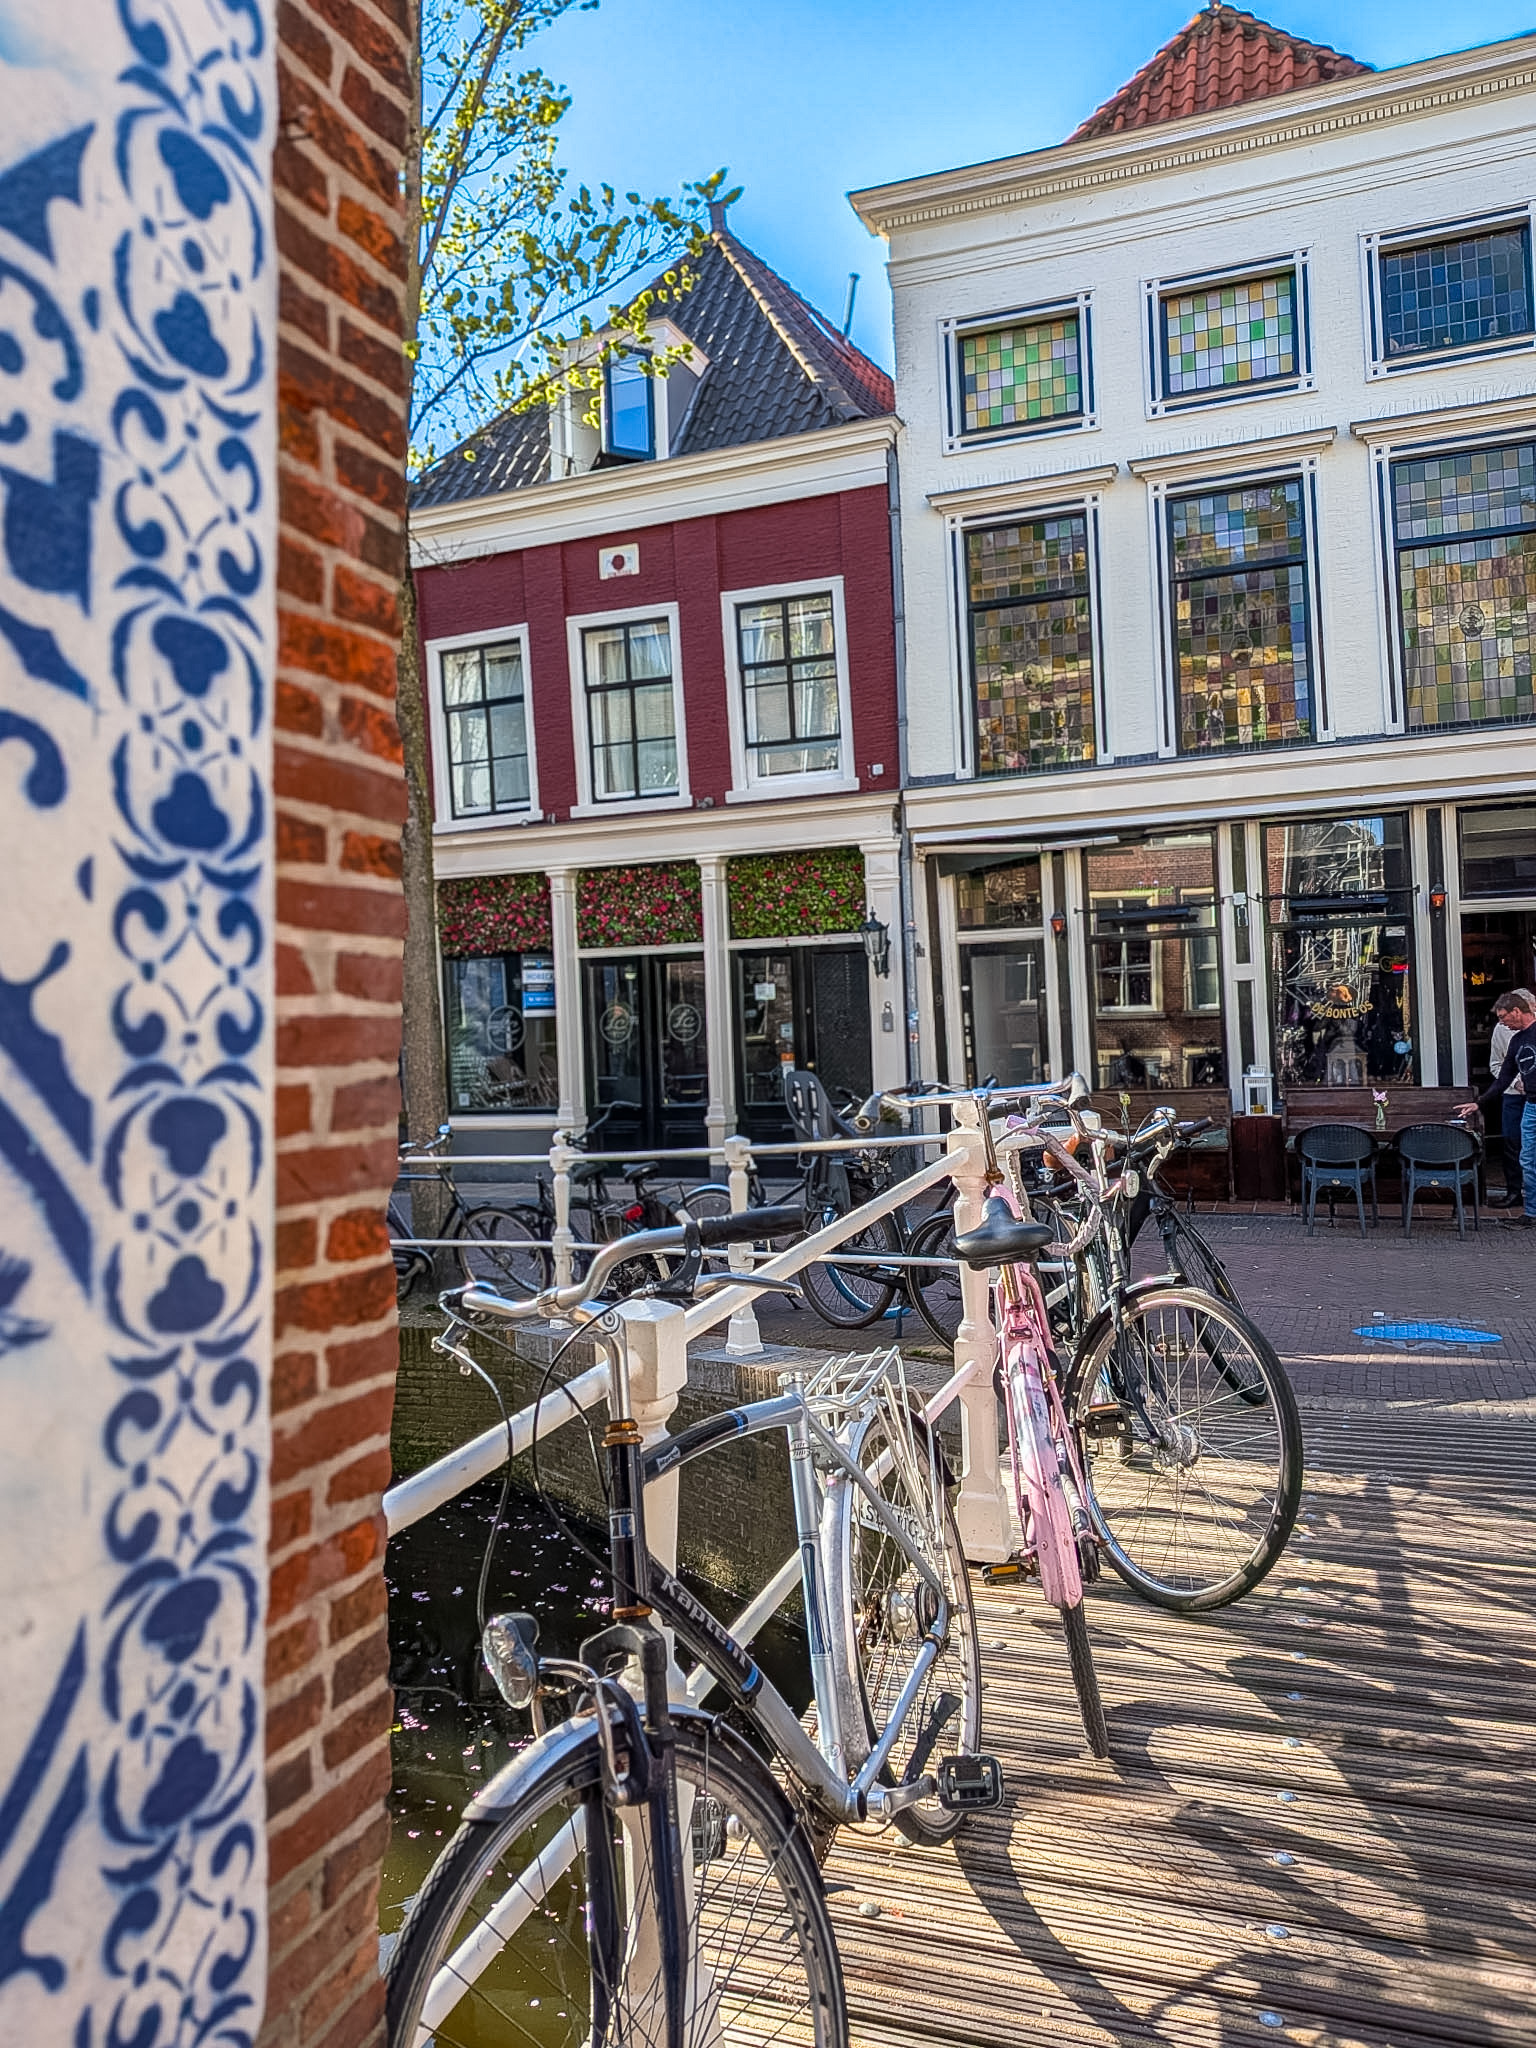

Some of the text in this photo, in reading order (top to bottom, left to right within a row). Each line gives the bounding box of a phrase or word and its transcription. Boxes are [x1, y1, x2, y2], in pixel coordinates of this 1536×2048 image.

[1312, 1000, 1373, 1018] DE BONTE OS
